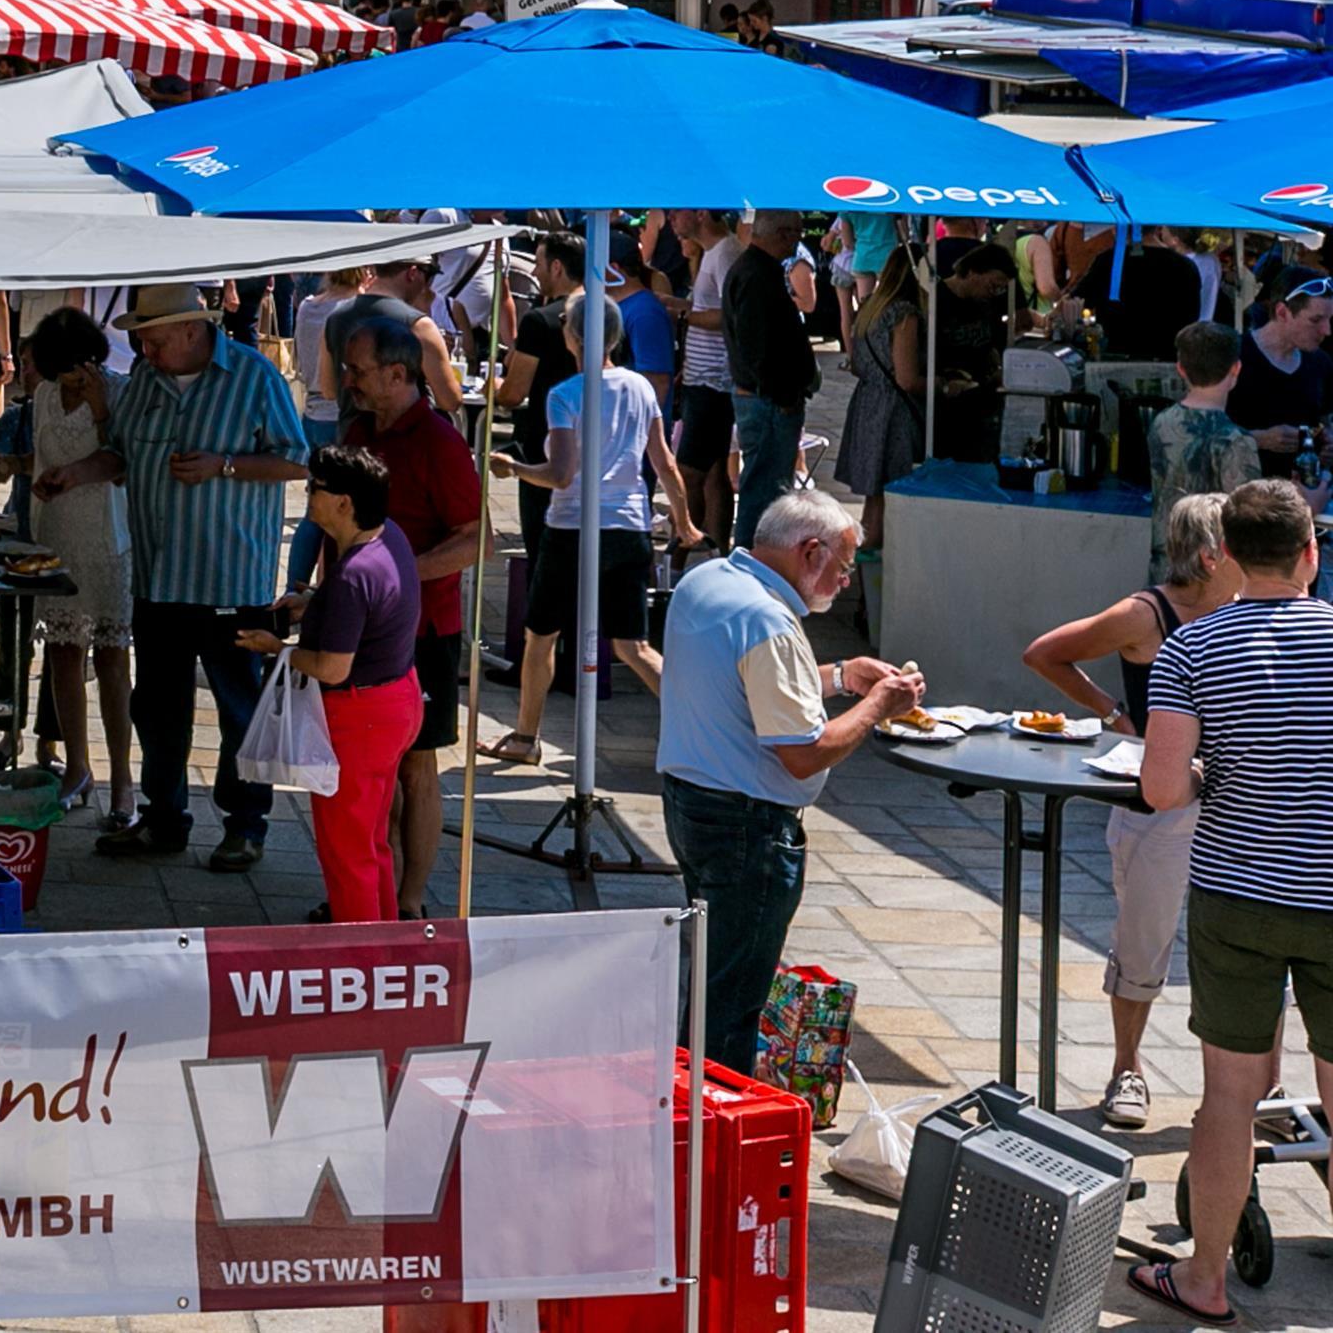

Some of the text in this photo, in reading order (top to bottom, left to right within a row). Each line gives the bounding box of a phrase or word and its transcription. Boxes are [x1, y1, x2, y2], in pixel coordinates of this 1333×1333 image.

[907, 184, 1062, 208] pepsi
[229, 964, 451, 1017] WEBER
[180, 1041, 492, 1228] W
[220, 1255, 442, 1286] WURSTWAREN
